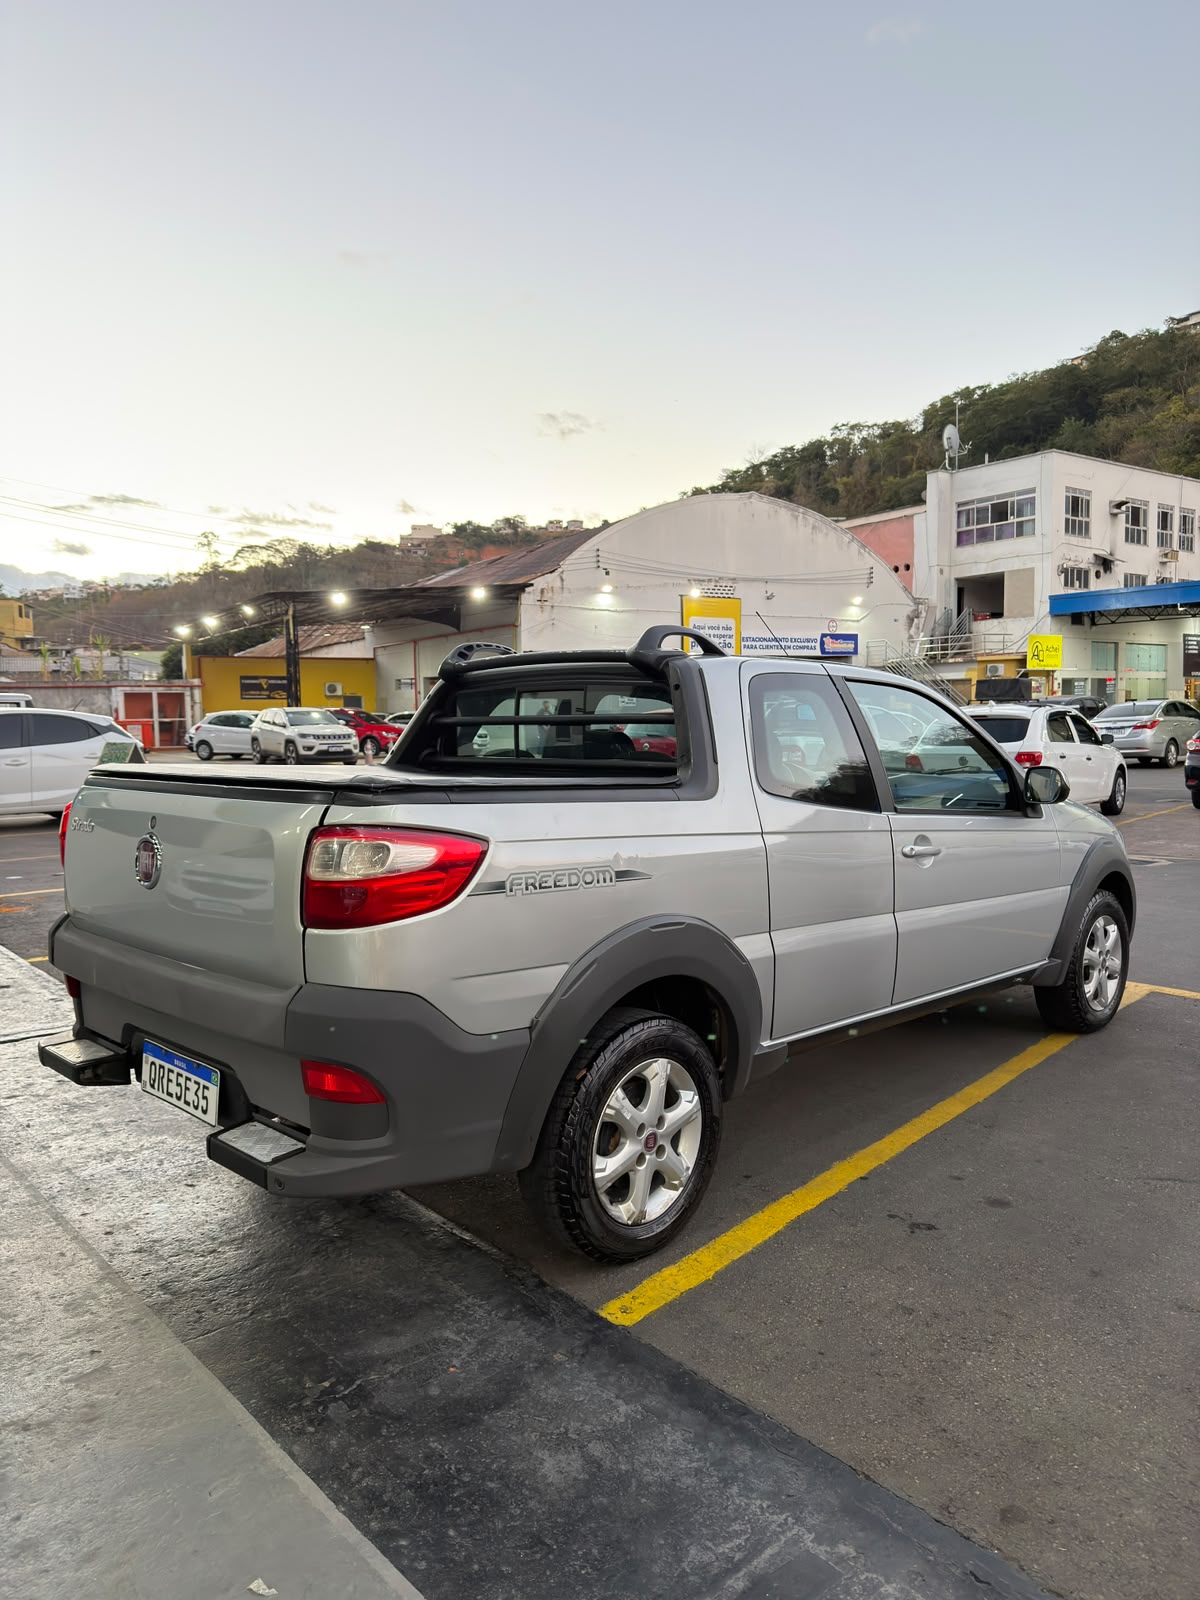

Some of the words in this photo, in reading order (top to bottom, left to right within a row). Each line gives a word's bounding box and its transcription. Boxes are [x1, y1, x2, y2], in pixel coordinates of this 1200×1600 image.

[692, 623, 706, 631] Aqui
[741, 636, 790, 644] ESTACIONAMENTO
[1045, 644, 1060, 653] Achei
[507, 867, 615, 895] FREEDOM
[148, 1060, 210, 1116] QRE5E35
